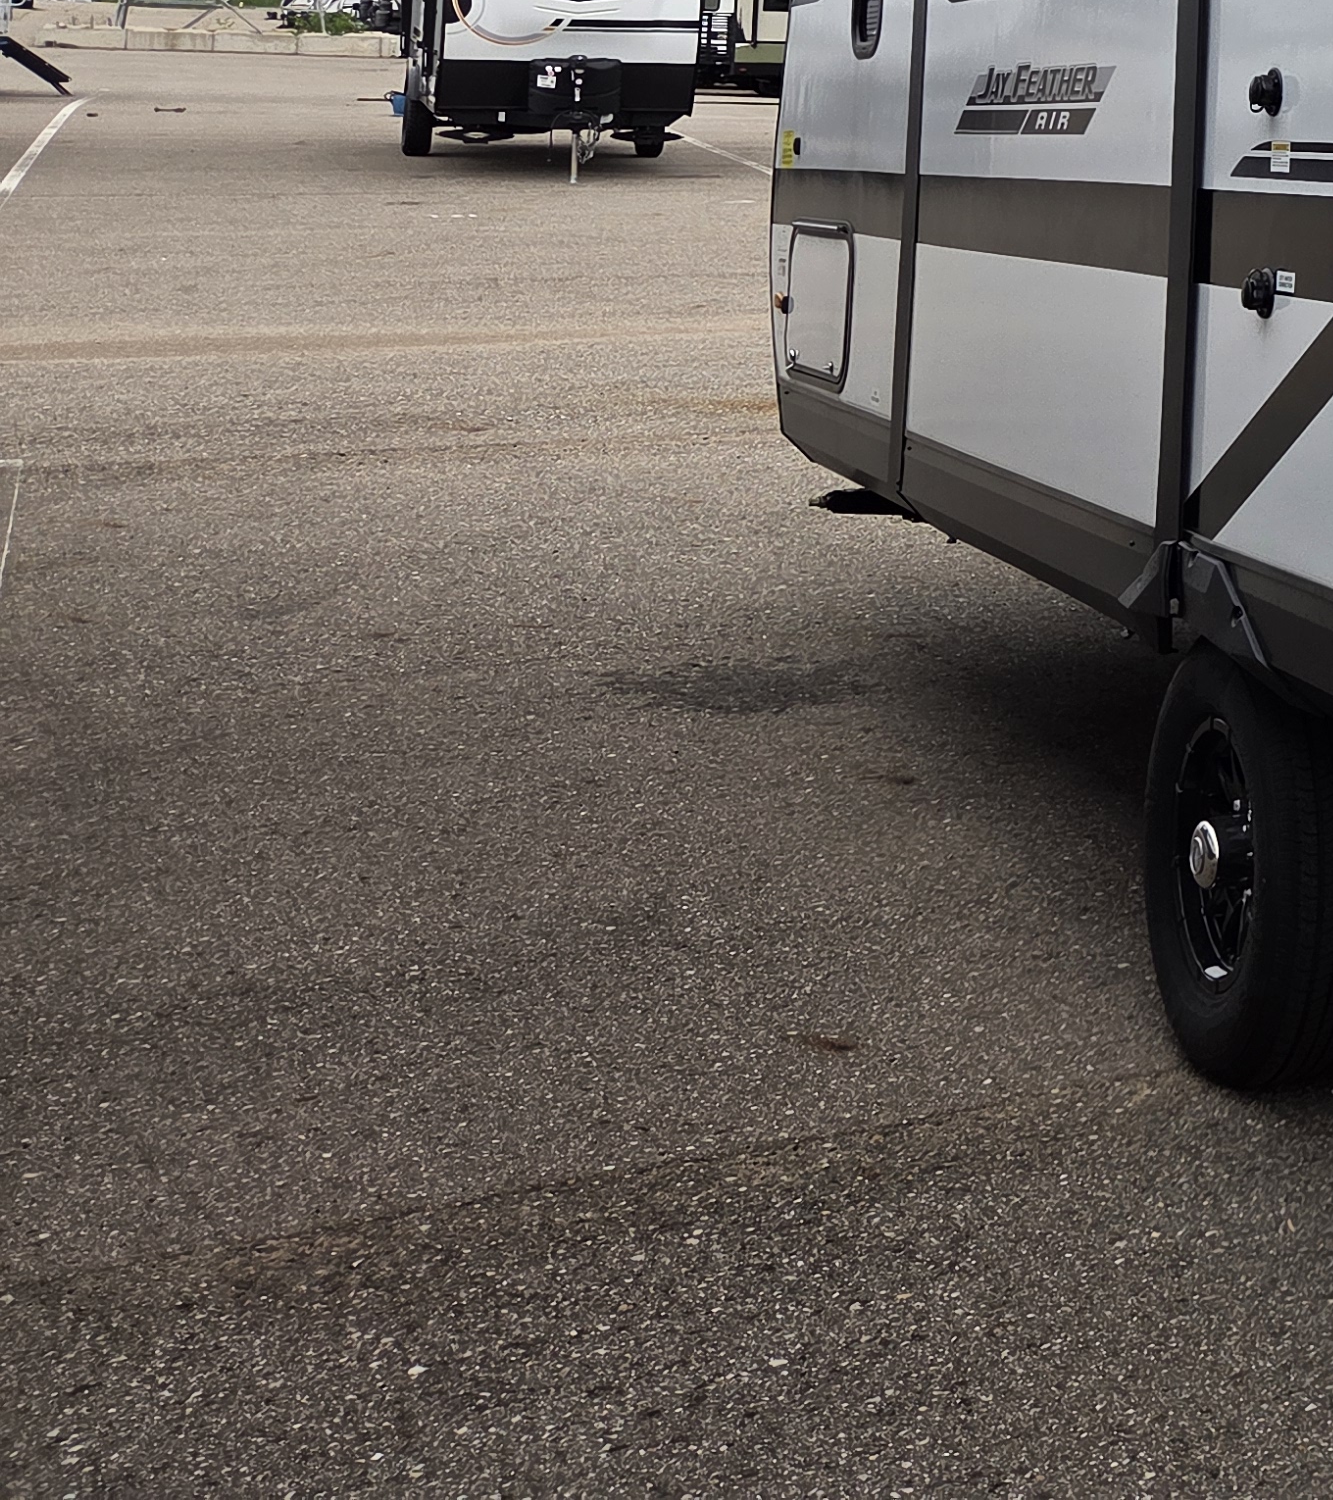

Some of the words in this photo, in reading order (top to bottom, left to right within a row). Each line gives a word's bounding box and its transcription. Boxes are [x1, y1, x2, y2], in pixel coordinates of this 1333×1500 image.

[976, 65, 1012, 102] JAY
[1010, 62, 1098, 102] FEATHER
[1035, 111, 1070, 131] AIR
